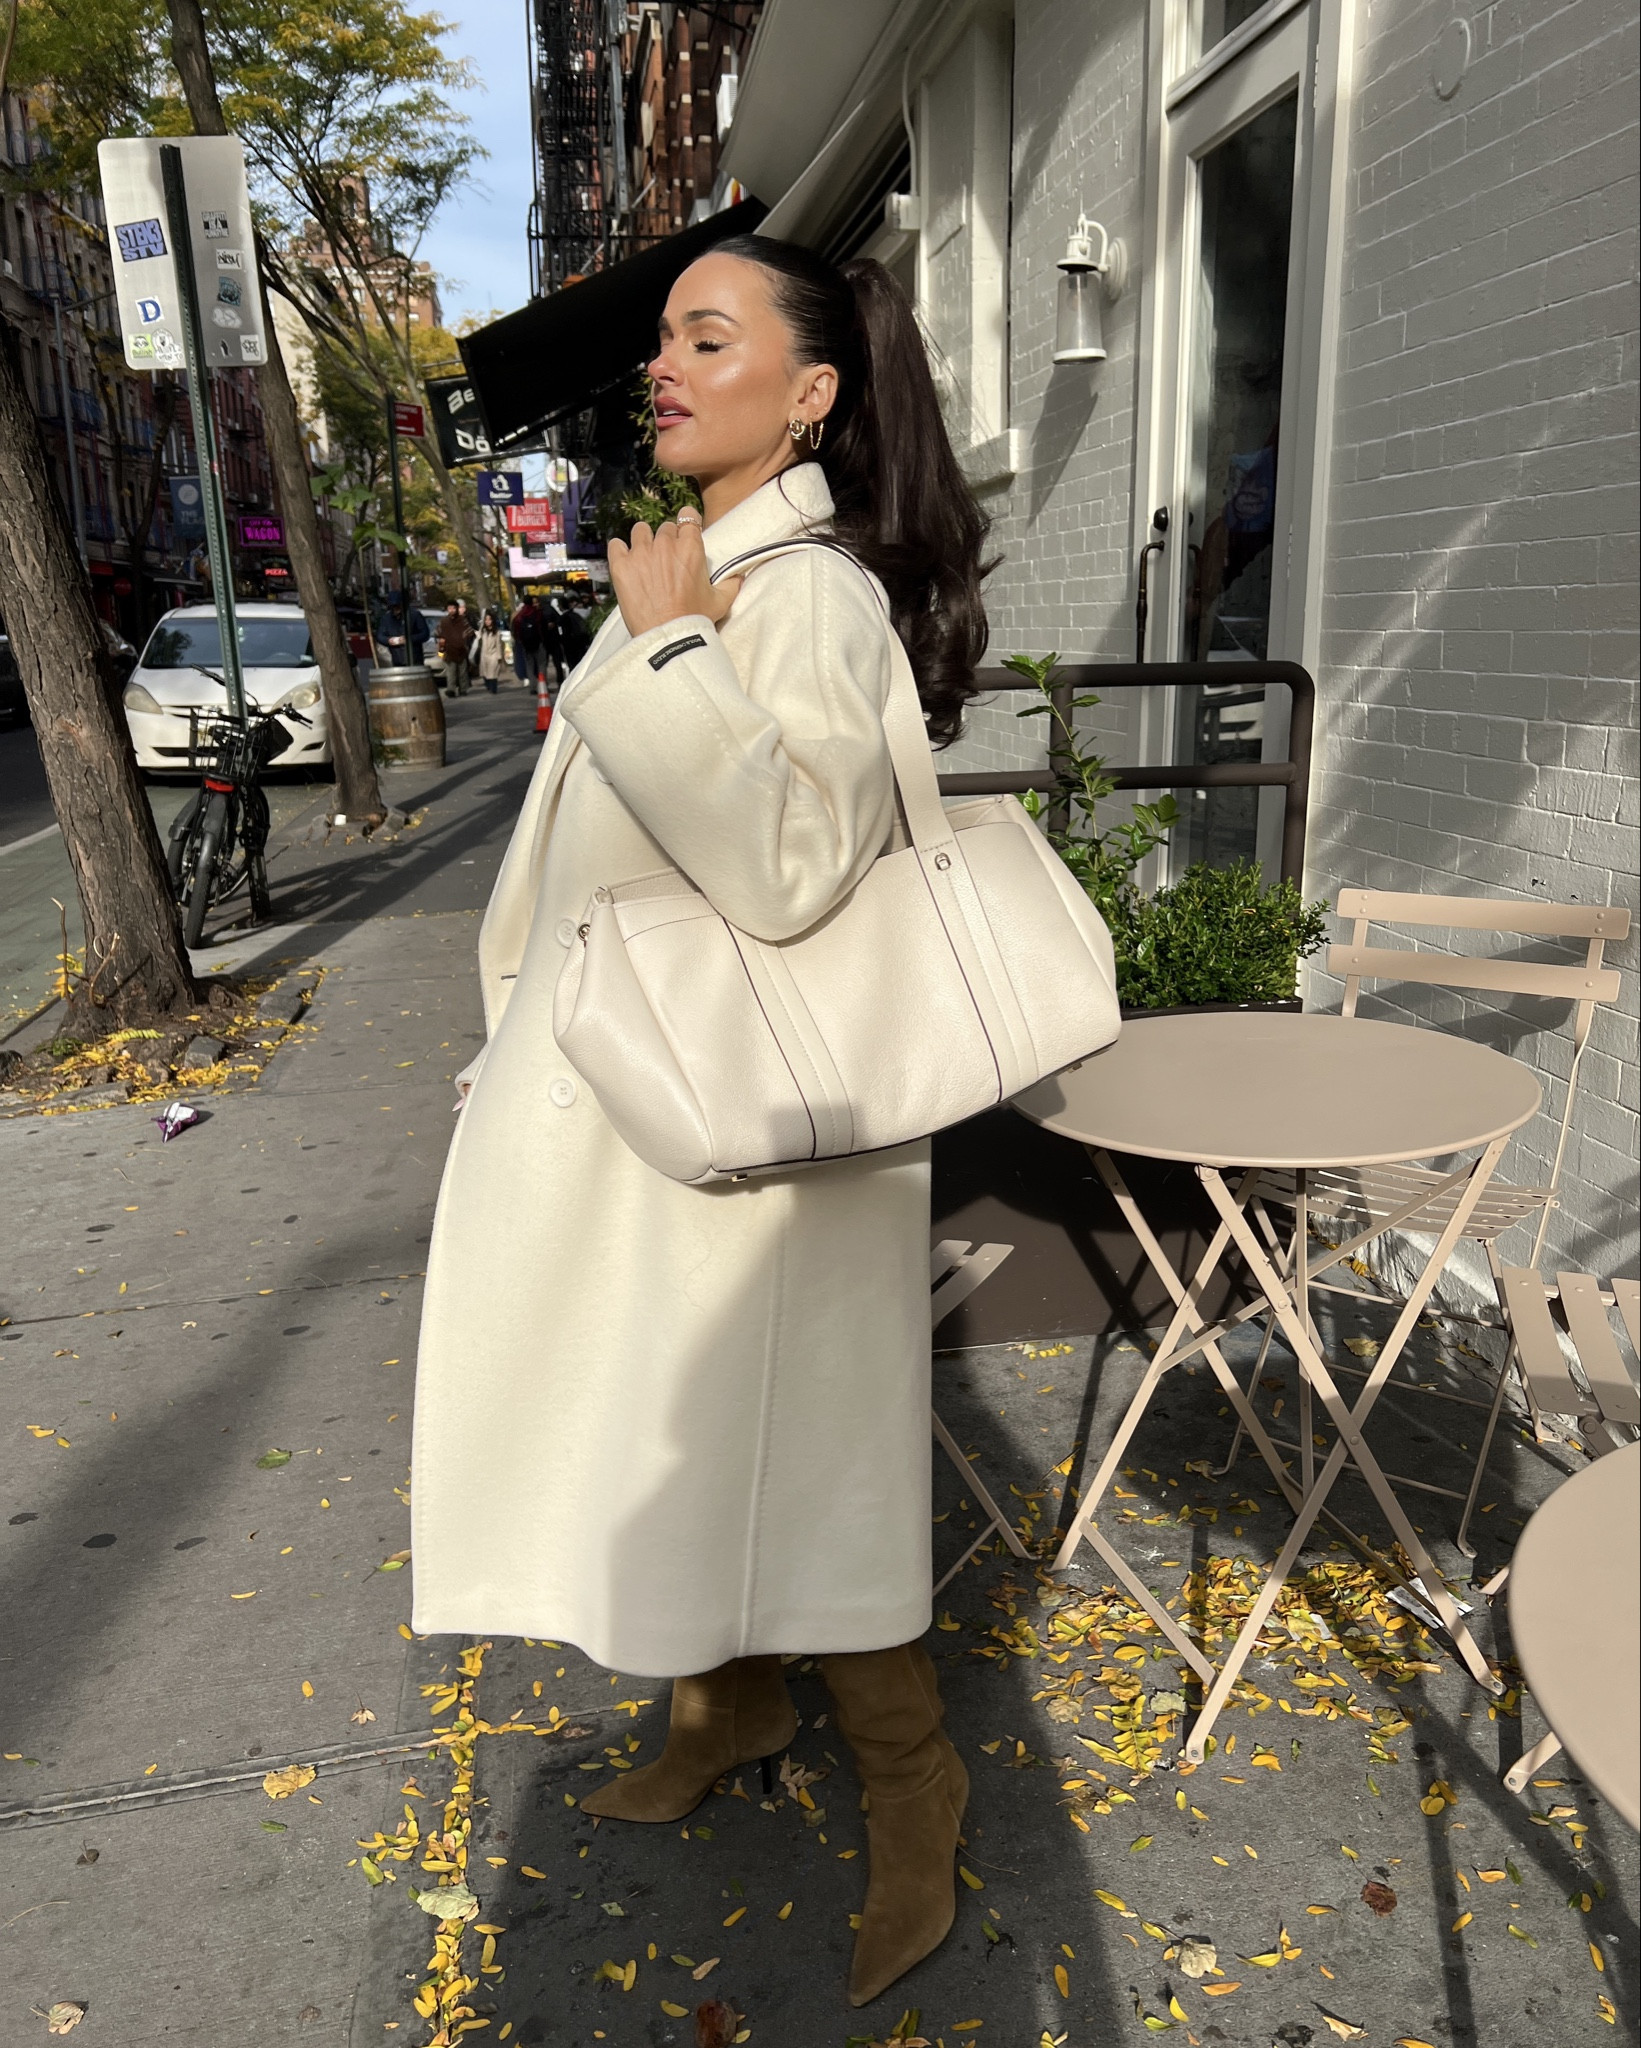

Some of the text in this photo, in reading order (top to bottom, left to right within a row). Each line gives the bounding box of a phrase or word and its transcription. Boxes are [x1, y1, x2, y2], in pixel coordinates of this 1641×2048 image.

[123, 243, 165, 261] STV
[138, 299, 161, 323] D
[244, 527, 281, 540] WAGON
